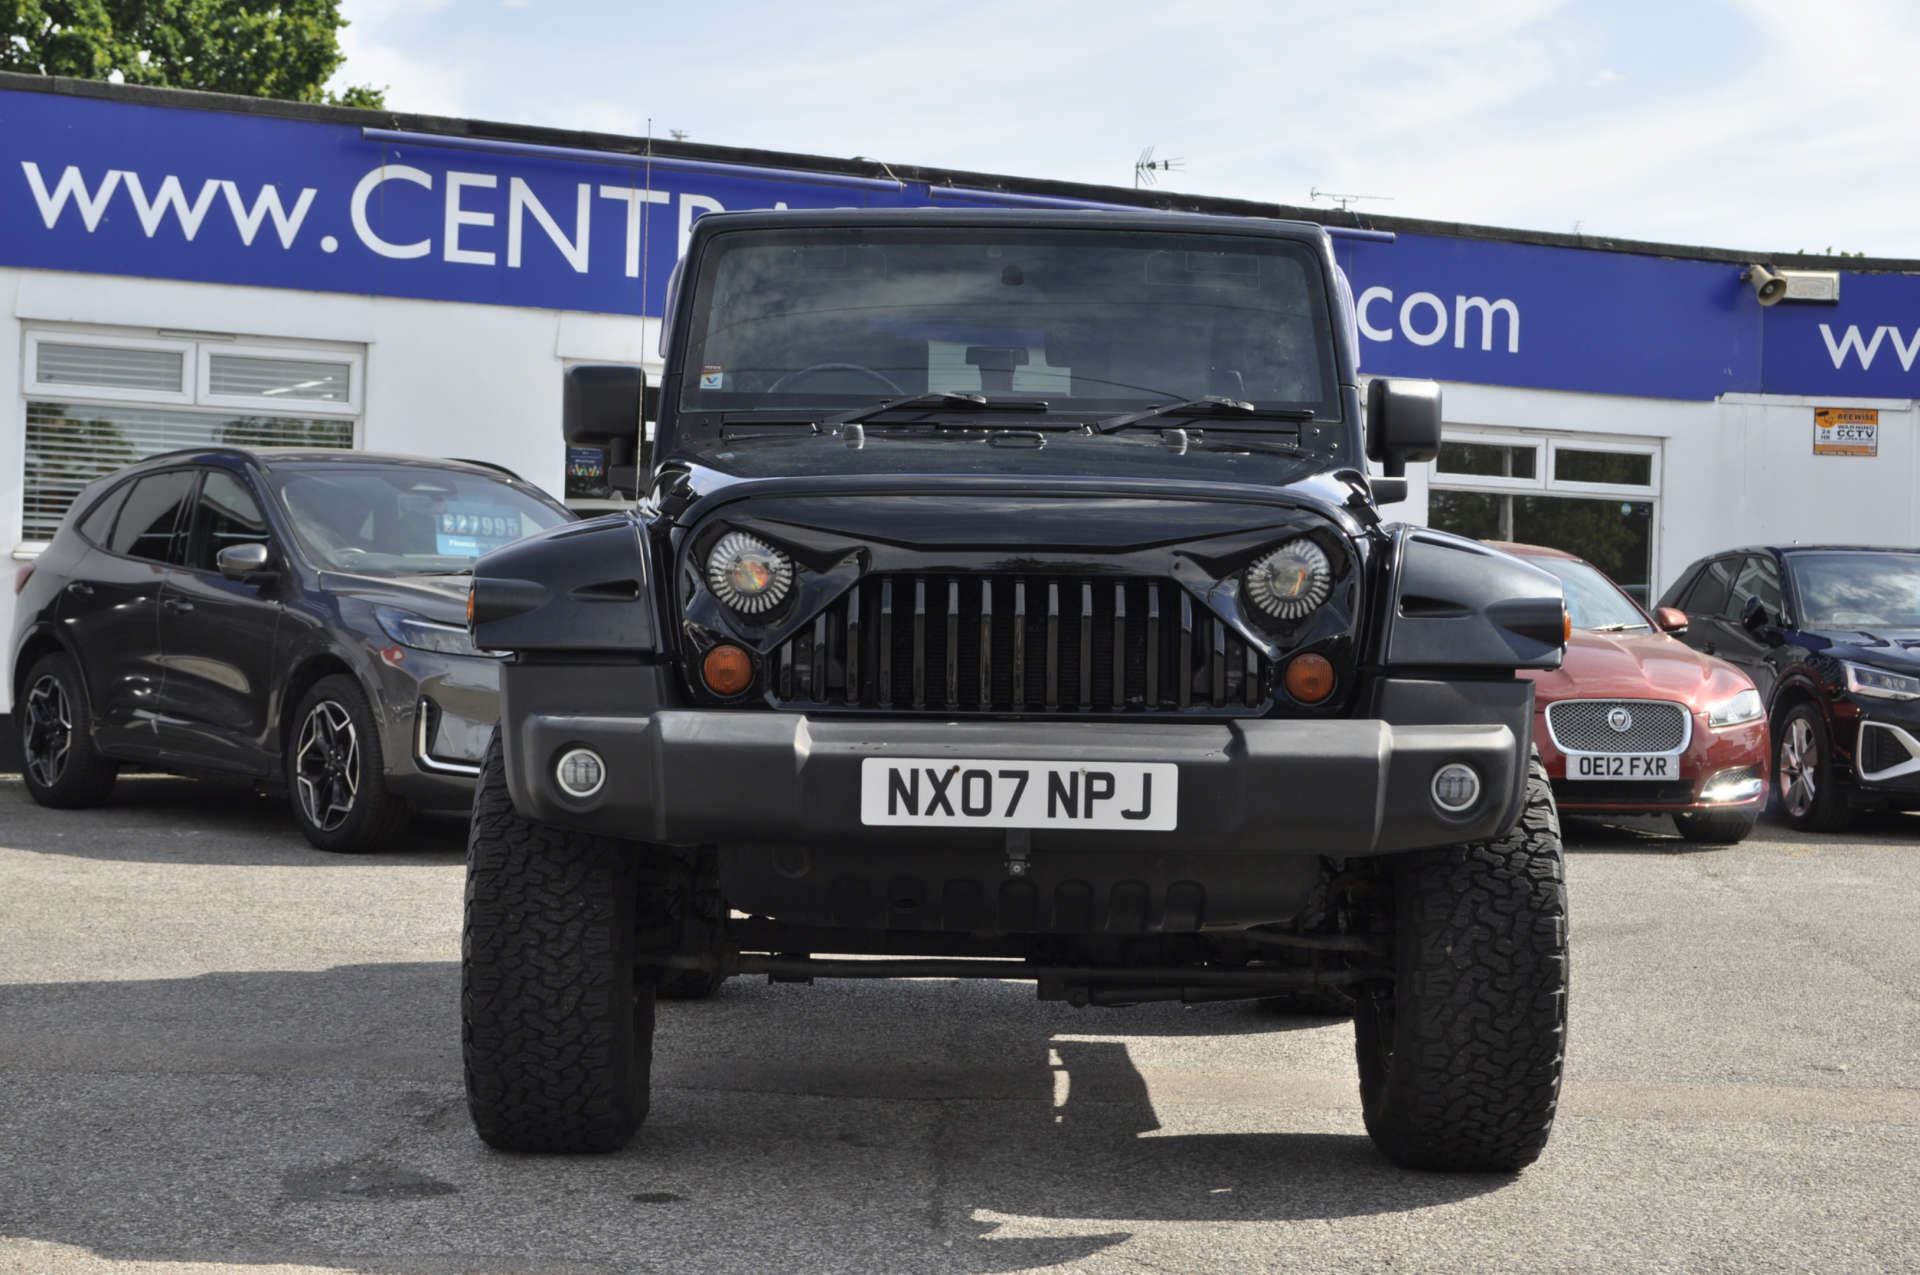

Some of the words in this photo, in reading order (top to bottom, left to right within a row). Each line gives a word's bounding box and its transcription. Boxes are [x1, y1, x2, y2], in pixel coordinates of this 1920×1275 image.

[20, 160, 788, 279] www.CENT
[1580, 757, 1623, 776] OE12
[1630, 757, 1667, 776] FXR
[888, 767, 1029, 817] NX07
[1048, 770, 1152, 821] NPJ
